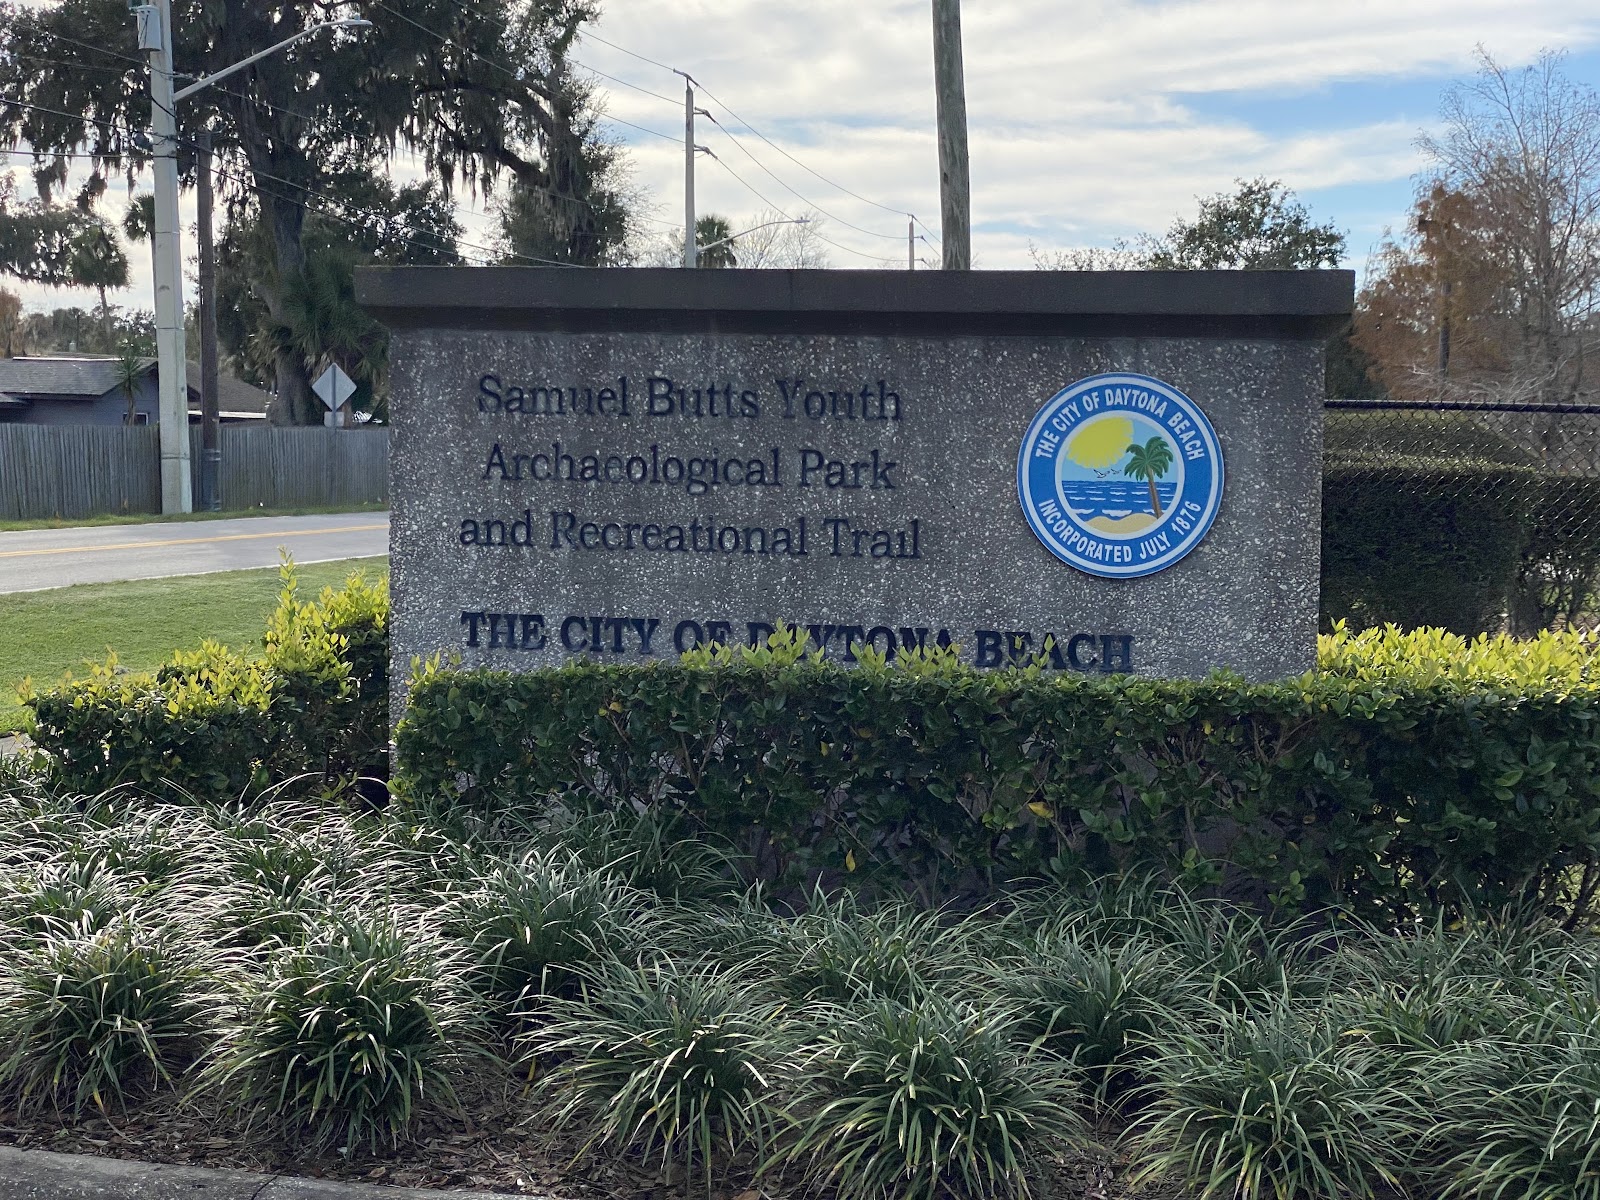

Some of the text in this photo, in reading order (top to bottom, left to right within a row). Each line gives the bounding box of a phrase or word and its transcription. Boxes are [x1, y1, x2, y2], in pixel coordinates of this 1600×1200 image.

[478, 374, 902, 421] Samuel Butts Youth
[1035, 388, 1205, 461] THE CITY OF DAYTONA BEACH
[482, 443, 897, 496] Archaeological Park
[459, 509, 921, 559] and Recreational Trail
[1039, 499, 1201, 563] INCORPORATED JULY 1876
[461, 611, 547, 650] THE
[560, 616, 659, 654] CITY
[673, 620, 732, 655] OF
[974, 629, 1135, 672] BEACH
